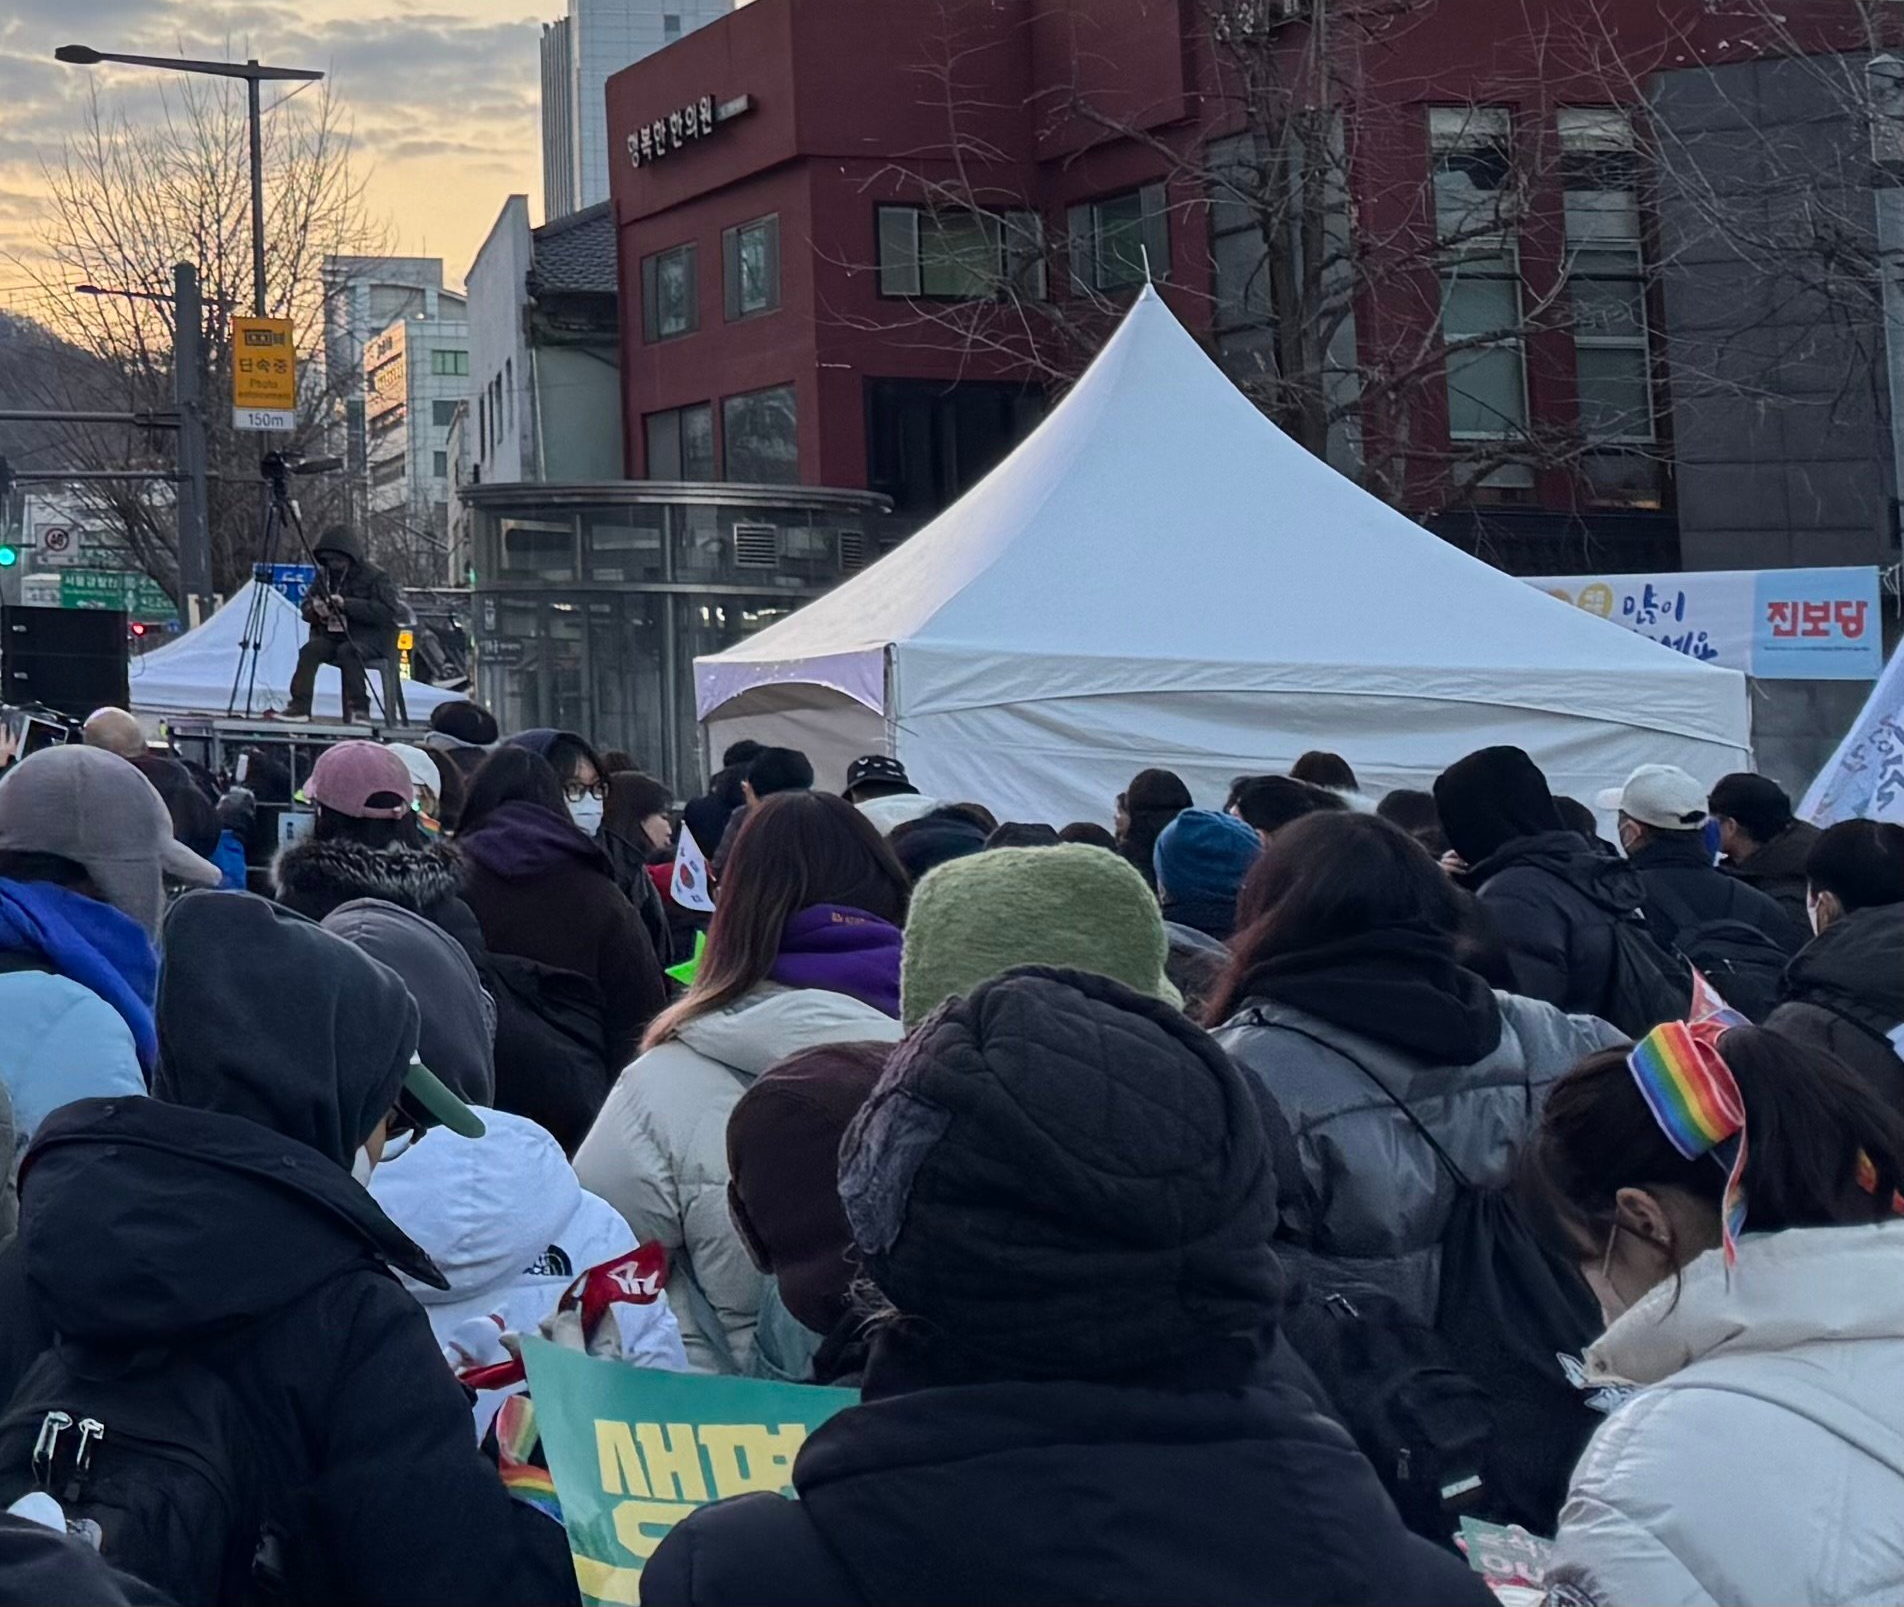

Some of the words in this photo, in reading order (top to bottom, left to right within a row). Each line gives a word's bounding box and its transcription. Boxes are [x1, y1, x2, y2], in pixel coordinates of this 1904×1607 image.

[239, 358, 288, 375] 단속중
[248, 413, 284, 427] 150m
[1623, 583, 1686, 625] 많이
[1767, 600, 1869, 639] 진보당
